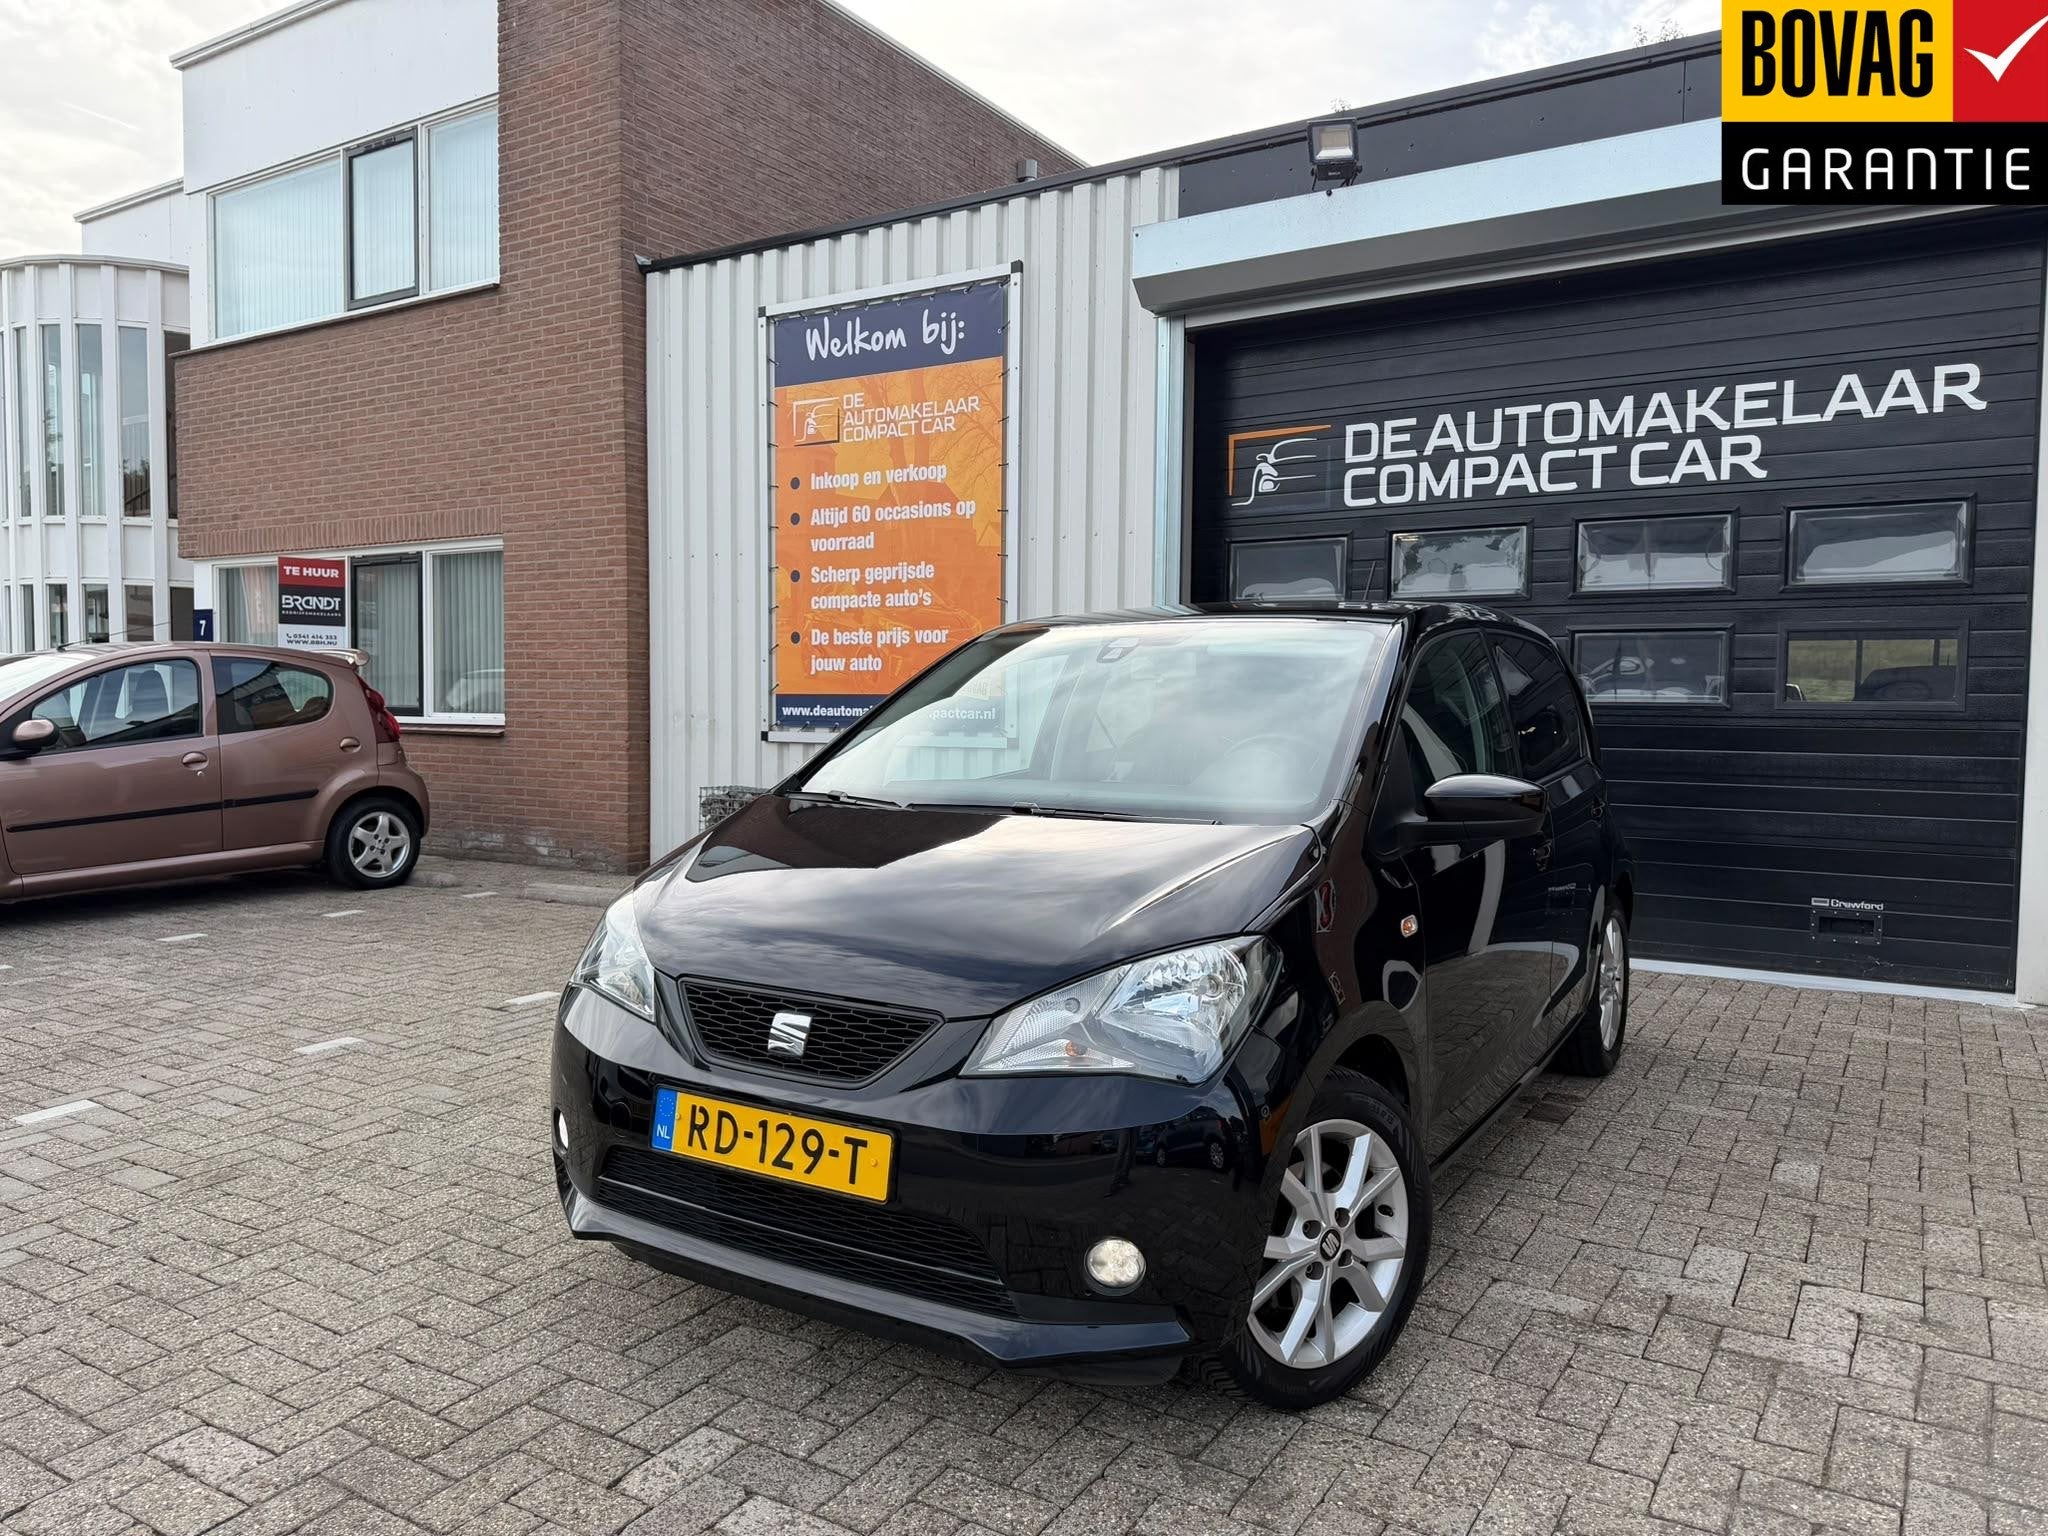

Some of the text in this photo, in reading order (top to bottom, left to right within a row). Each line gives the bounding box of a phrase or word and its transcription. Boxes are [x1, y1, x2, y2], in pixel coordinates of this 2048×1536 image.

[806, 309, 965, 361] Welkom bij:
[843, 392, 864, 409] DE
[843, 395, 980, 426] AUTOMAKELAAR
[1345, 363, 1988, 464] DE AUTOMAKELAAR
[843, 416, 956, 442] COMPACT CAR
[811, 464, 947, 490] Inkoop en verkoop
[1343, 434, 1768, 507] COMPACT CAR
[811, 500, 976, 527] Altijd 60 occasions op
[811, 532, 874, 552] voorraad
[283, 566, 340, 578] TE HUUR
[811, 561, 935, 585] Scherp geprijsde
[811, 590, 932, 611] compacte auto's
[199, 620, 206, 636] 7
[811, 627, 948, 648] De beste prijs voor
[810, 655, 882, 674] jouw auto
[656, 1124, 670, 1139] NL
[687, 1104, 868, 1185] RD-129-T
